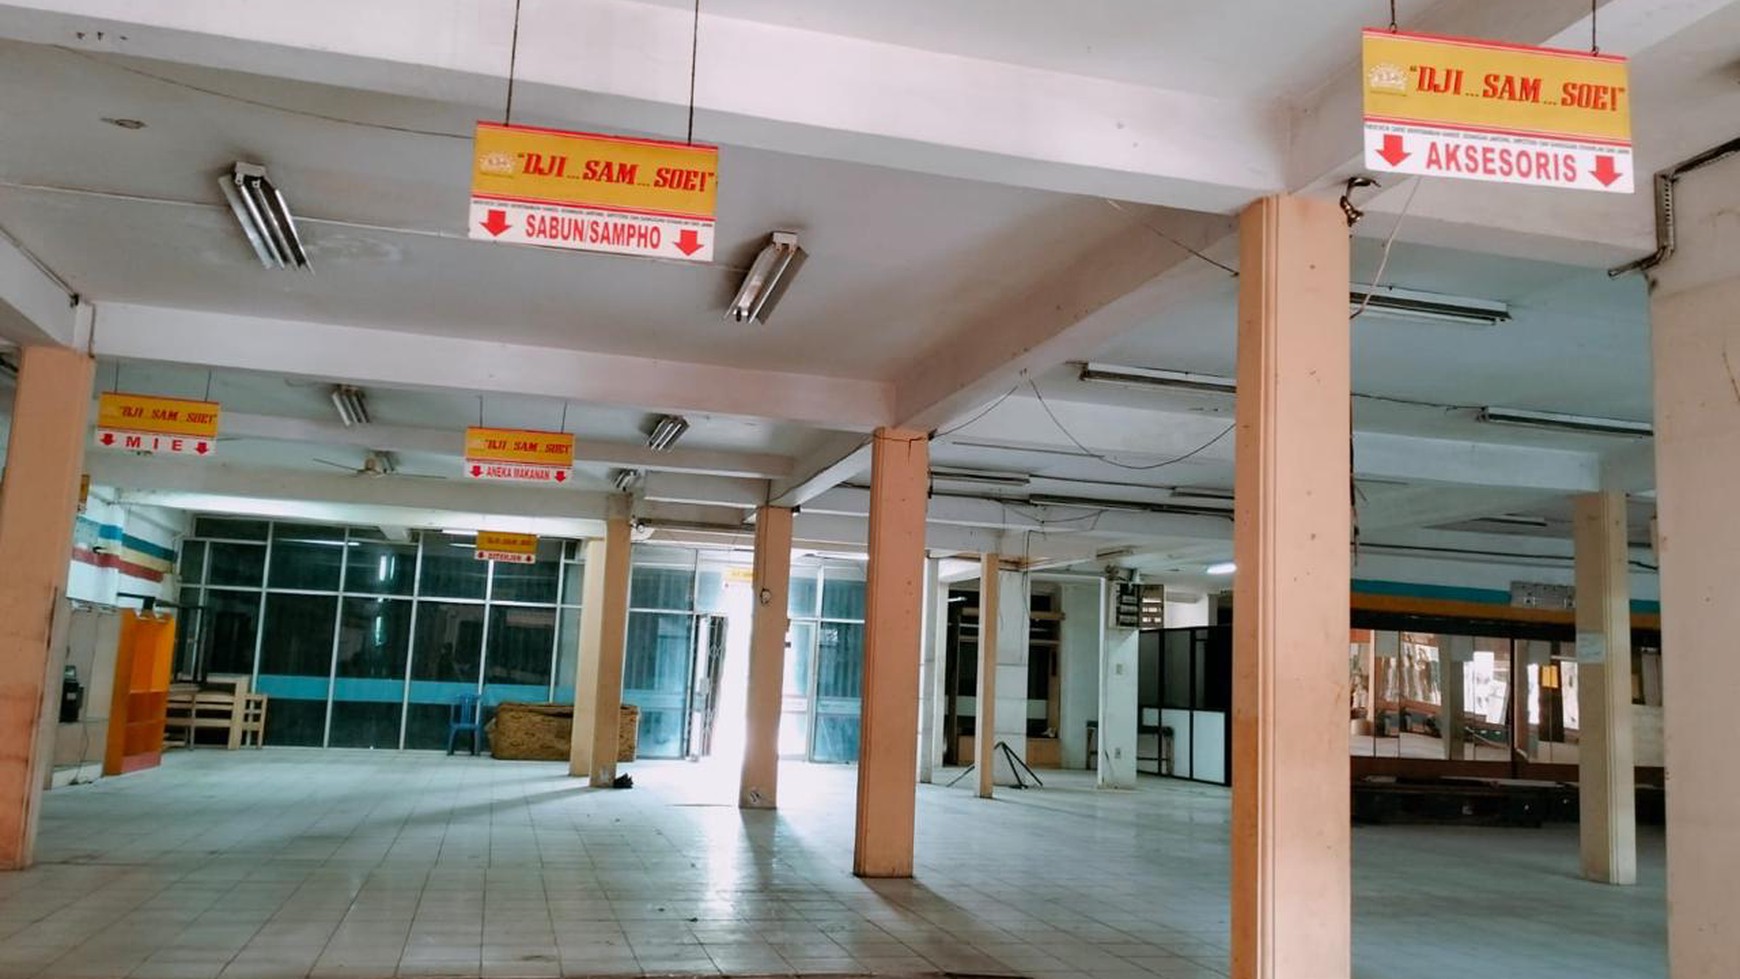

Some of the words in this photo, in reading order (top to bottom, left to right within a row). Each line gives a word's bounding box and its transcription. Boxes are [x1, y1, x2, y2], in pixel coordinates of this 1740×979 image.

[1482, 74, 1543, 104] SAM
[582, 160, 640, 186] SAM
[1426, 141, 1578, 183] AKSESORIS
[486, 466, 512, 478] ANEKA
[513, 468, 551, 481] MAKANAN
